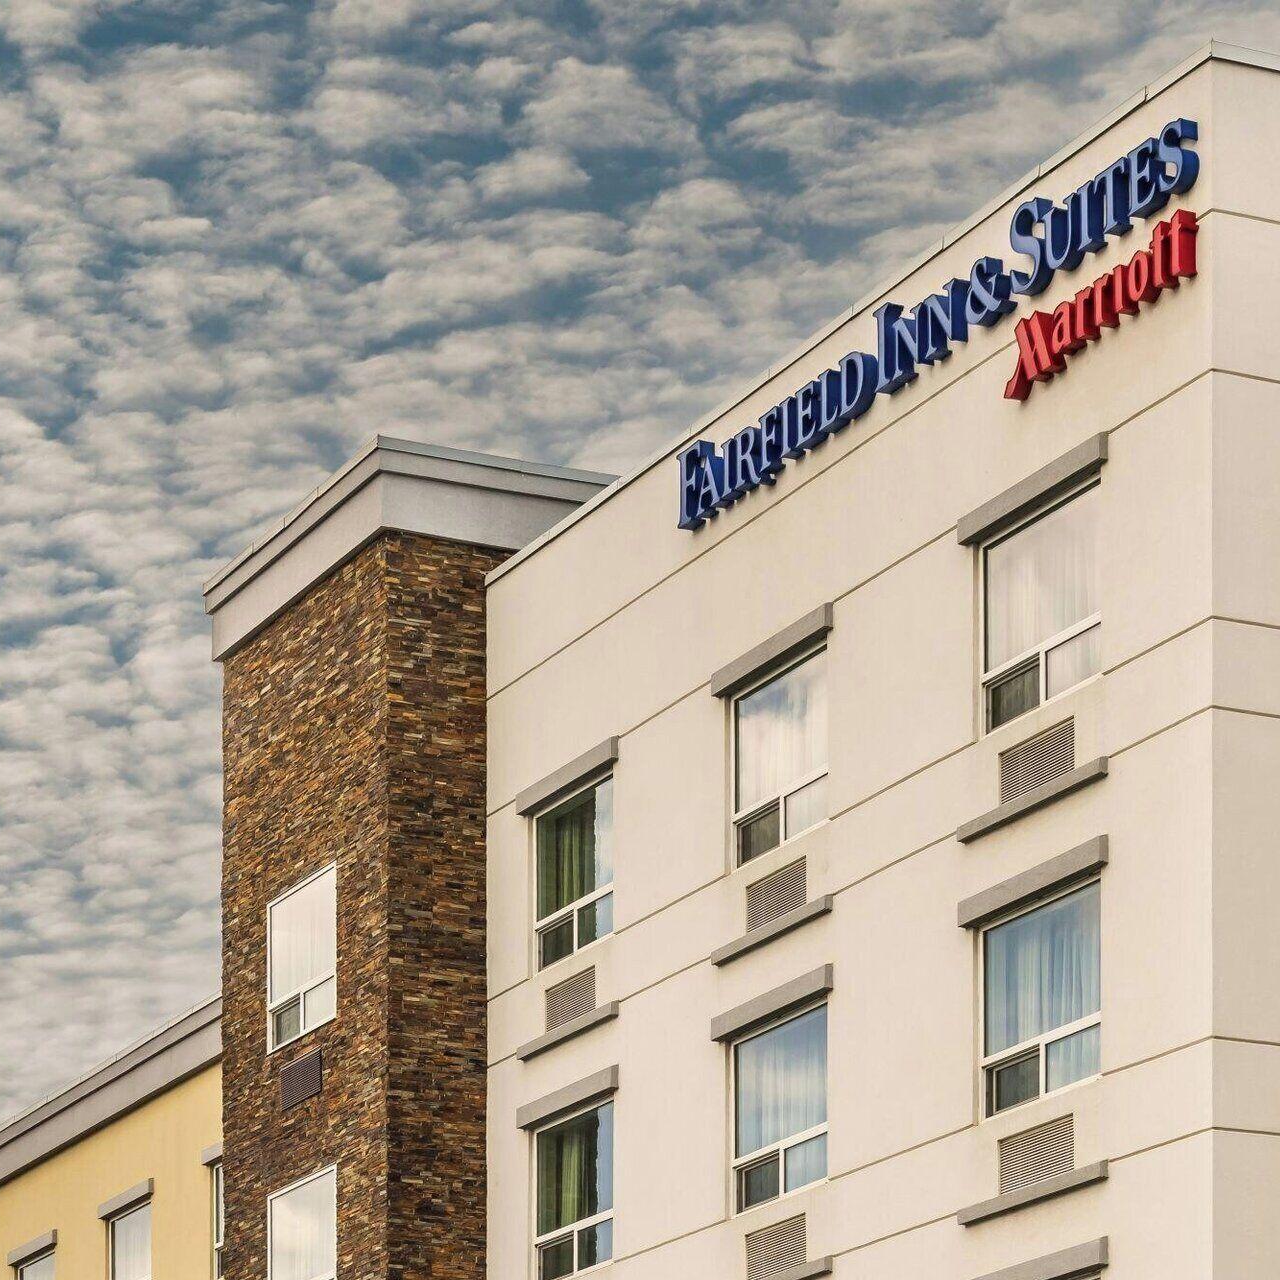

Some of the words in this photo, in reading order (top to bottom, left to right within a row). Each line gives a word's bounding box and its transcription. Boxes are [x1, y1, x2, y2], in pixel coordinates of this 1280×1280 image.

[677, 351, 878, 531] FAIRFIELD
[872, 277, 969, 394] INN
[964, 255, 1018, 328] &
[1008, 117, 1199, 297] SUITES
[1003, 208, 1199, 402] Marriott
